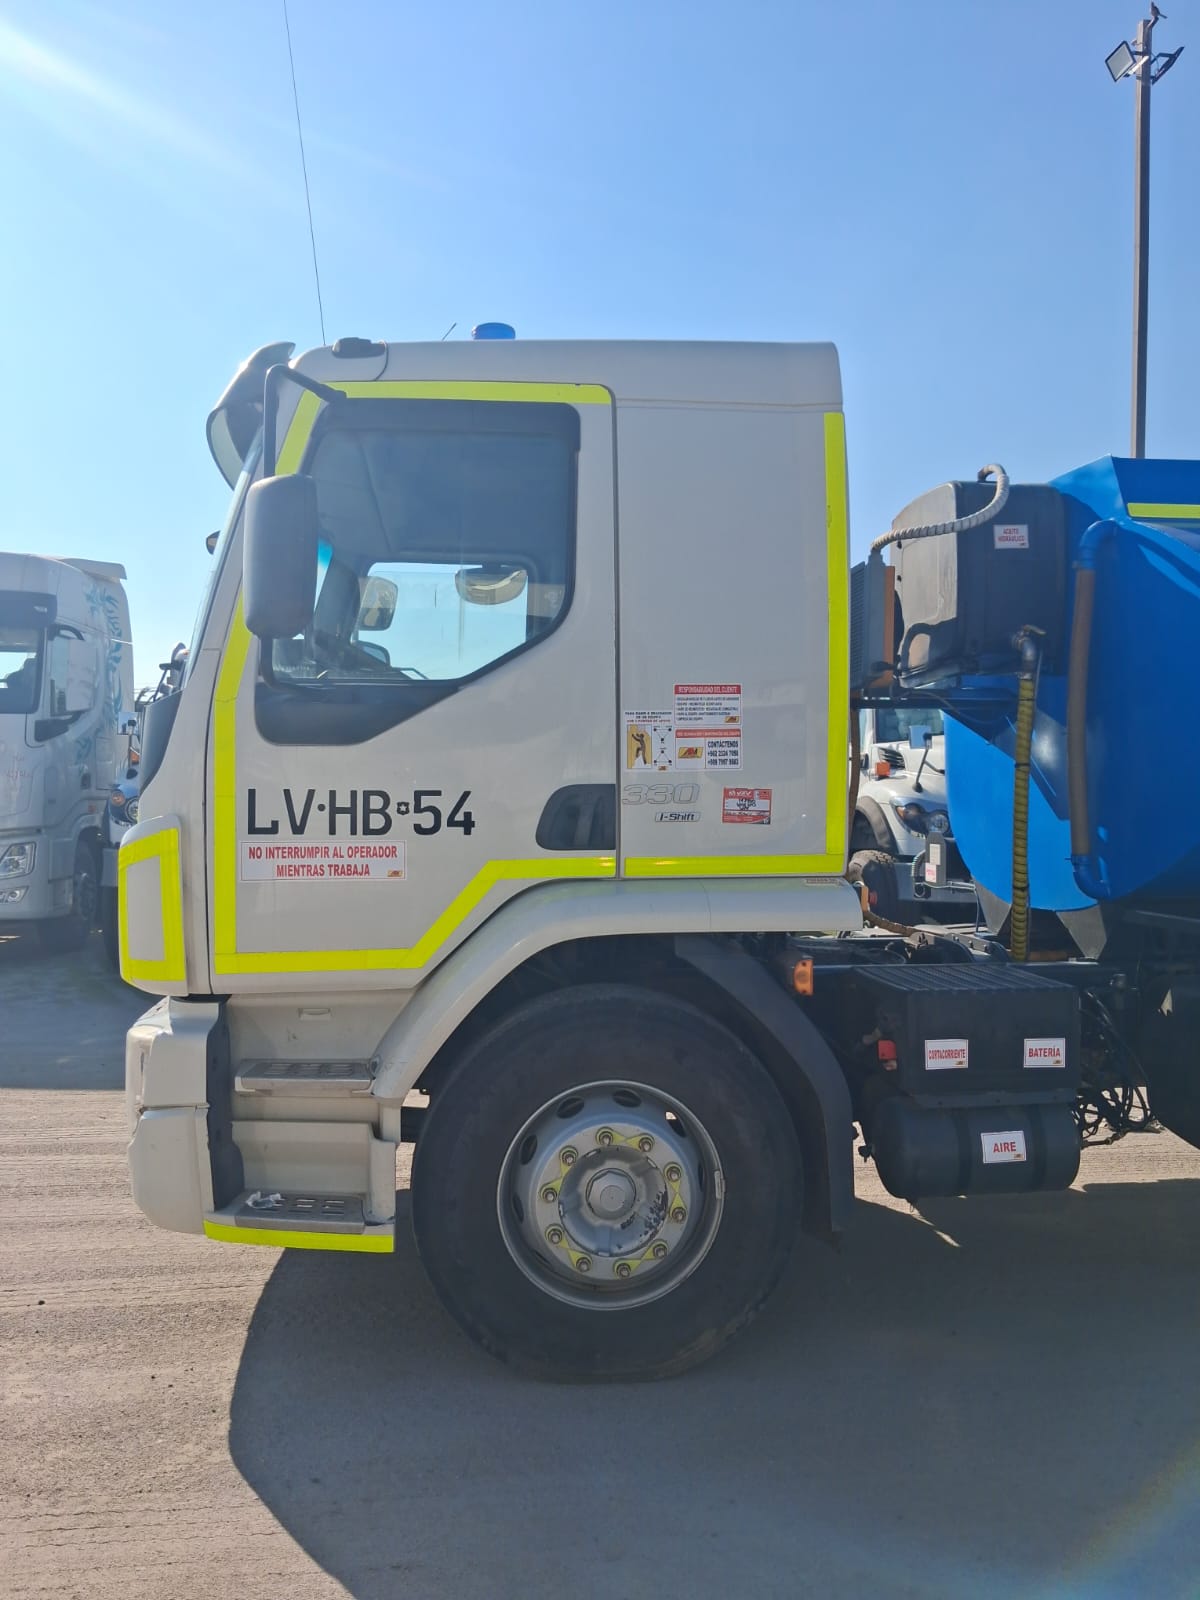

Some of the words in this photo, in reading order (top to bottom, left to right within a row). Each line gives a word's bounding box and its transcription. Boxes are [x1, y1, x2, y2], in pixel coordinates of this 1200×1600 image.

[622, 783, 700, 805] 330
[660, 812, 695, 821] I-Shift
[248, 846, 262, 859] NO
[265, 846, 330, 859] INTERRUMPIR
[332, 846, 344, 858] AL
[347, 845, 398, 858] OPERADOR
[276, 864, 325, 877] MIENTRAS
[328, 863, 370, 876] TRABAJA
[1028, 1045, 1061, 1058] BATERÍA
[993, 1141, 1017, 1153] AIRE
